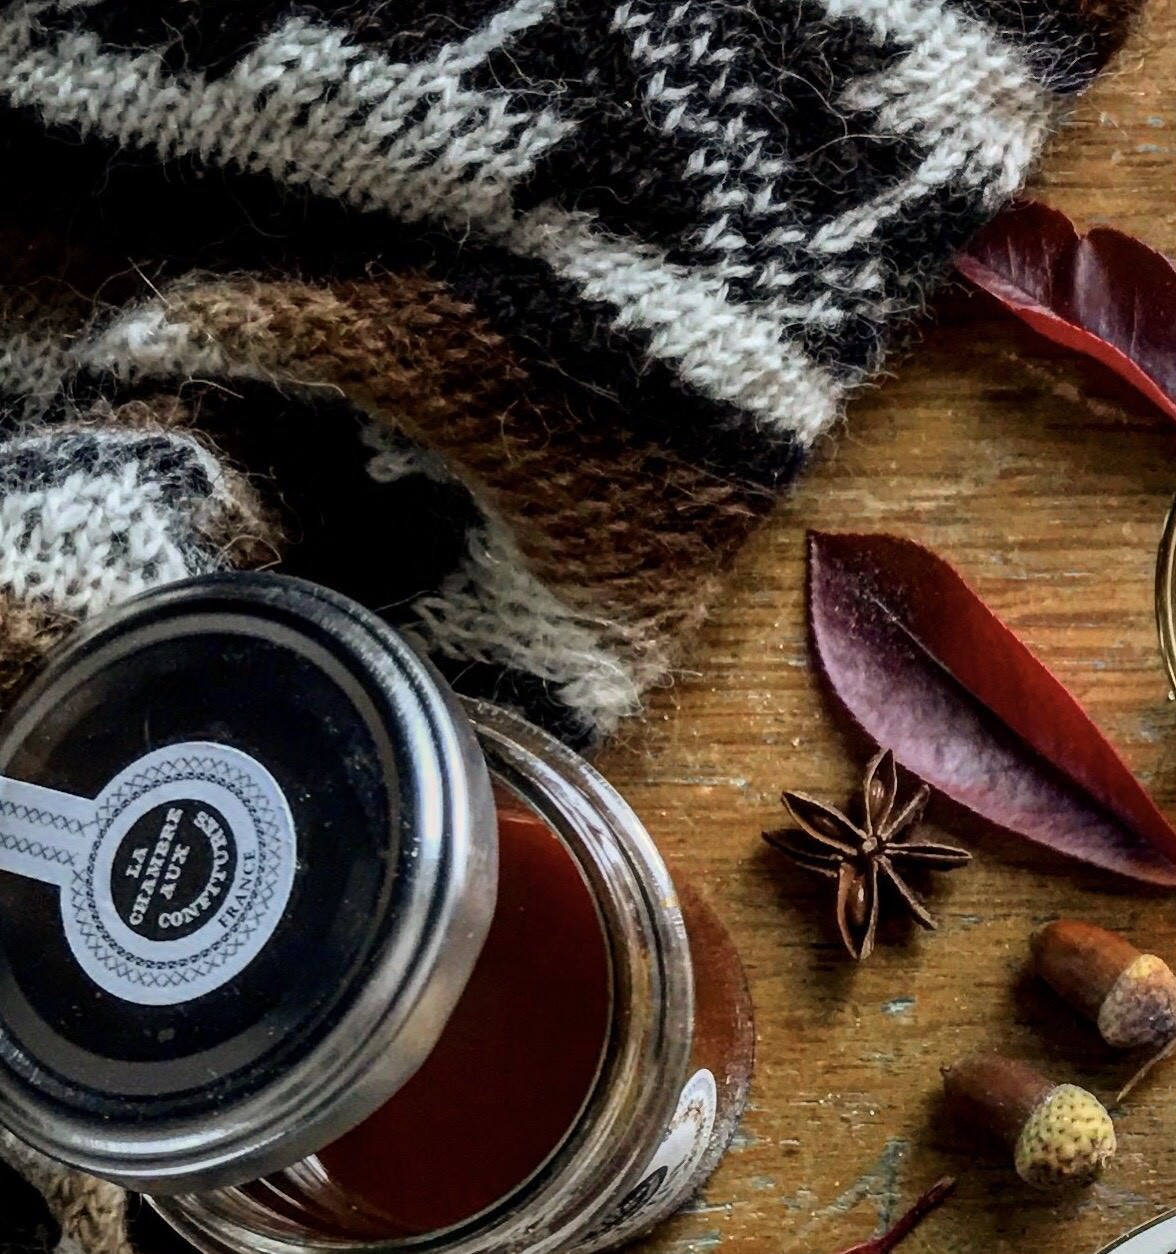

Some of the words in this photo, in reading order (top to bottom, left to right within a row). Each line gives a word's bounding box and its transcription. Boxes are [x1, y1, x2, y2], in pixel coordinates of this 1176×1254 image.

[125, 847, 148, 879] LA
[129, 807, 184, 926] CHAMBRE
[158, 810, 229, 929] CONFITURES
[160, 843, 191, 900] AUX
[217, 848, 257, 929] FRANCE
